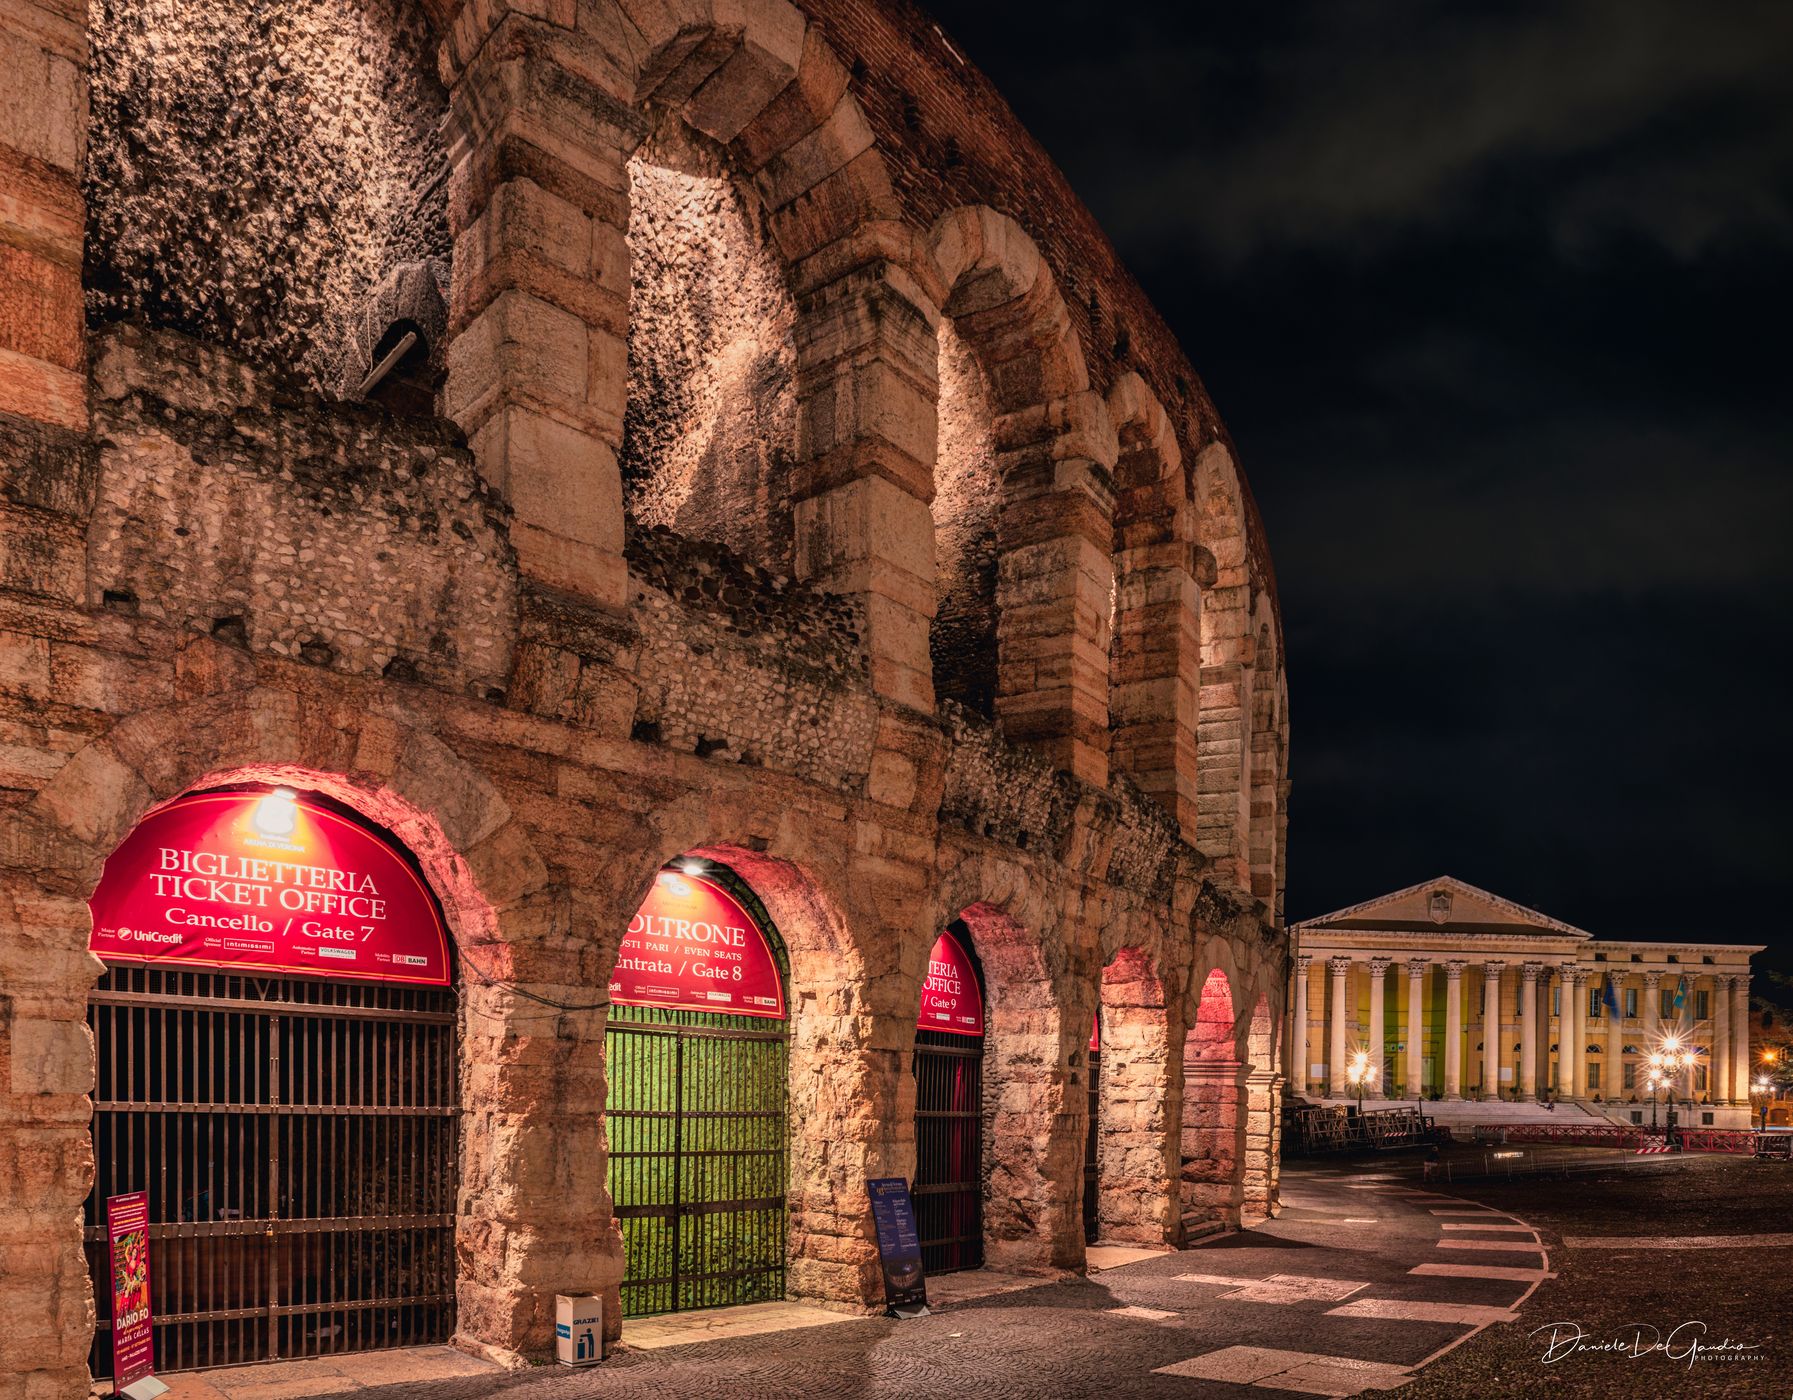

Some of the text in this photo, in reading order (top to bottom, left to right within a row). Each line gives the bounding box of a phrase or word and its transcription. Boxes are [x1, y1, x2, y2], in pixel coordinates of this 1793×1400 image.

[158, 847, 380, 896] BIGLIETTERIA
[149, 873, 387, 920] TICKET OFFICE
[165, 907, 273, 933] Cancello
[302, 921, 355, 941] Gate
[360, 925, 375, 942] 7
[627, 913, 746, 947] OLTRONE
[133, 930, 183, 944] UniCredit
[620, 939, 641, 949] STI
[645, 941, 669, 952] PARI
[684, 946, 710, 957] EVEN
[714, 950, 742, 961] SEATS
[407, 957, 426, 965] BAHN
[928, 960, 958, 979] TERIA
[692, 963, 729, 980] Gate
[732, 965, 742, 981] 8
[608, 982, 622, 992] edit
[923, 975, 961, 995] OFFICE
[930, 996, 950, 1009] Gate
[950, 998, 957, 1010] 9
[116, 1311, 138, 1331] DARIO
[139, 1307, 149, 1321] FO
